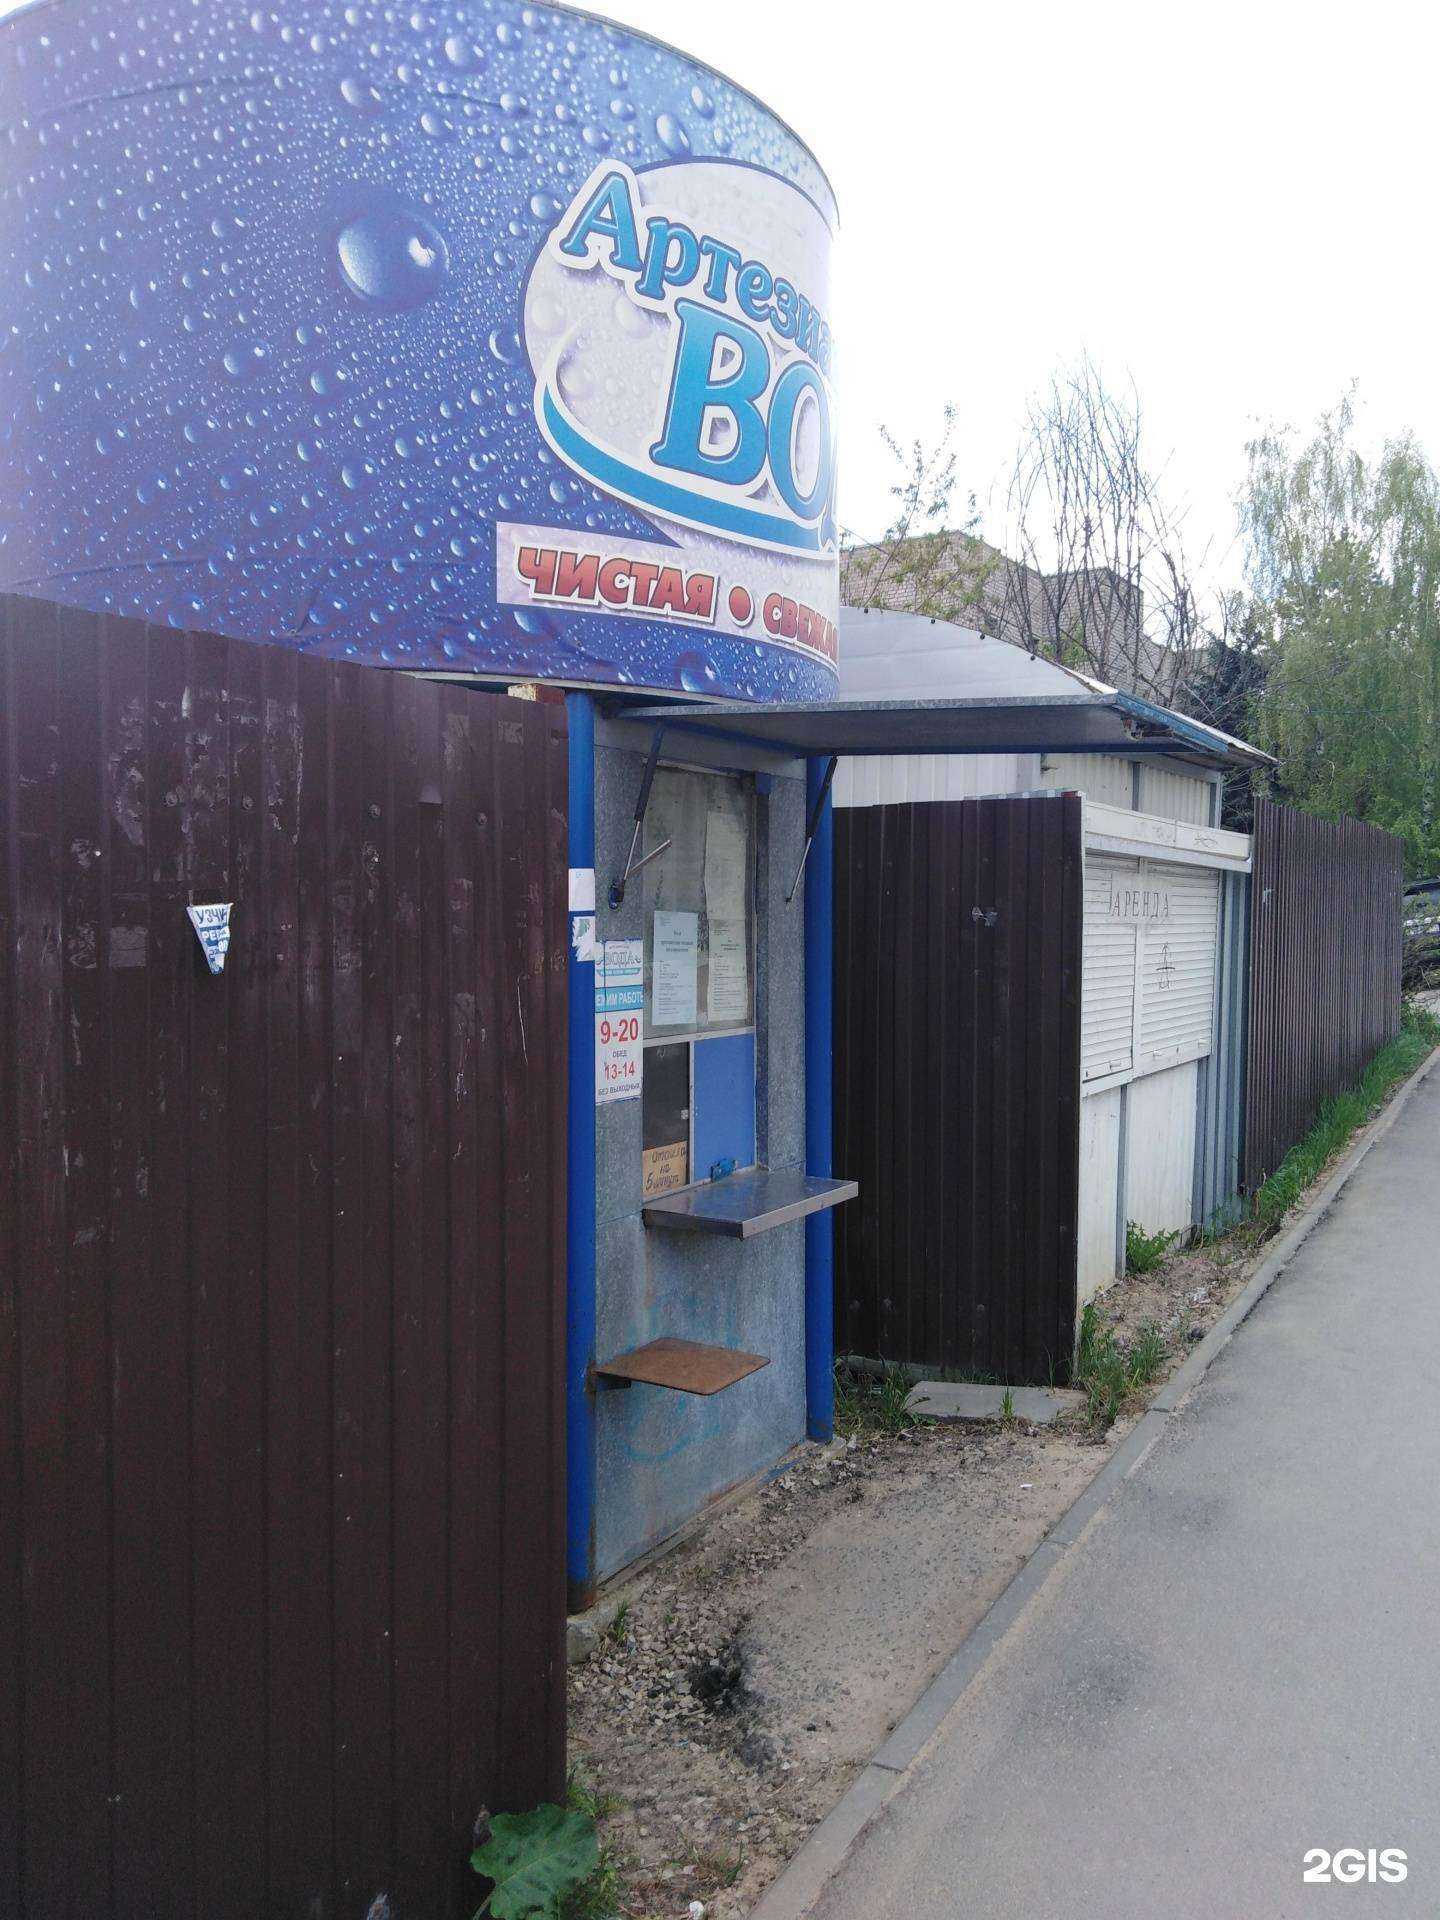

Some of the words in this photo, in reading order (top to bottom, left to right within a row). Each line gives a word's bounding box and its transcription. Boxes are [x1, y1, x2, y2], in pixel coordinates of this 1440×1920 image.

[518, 547, 716, 617] ЧИСТАЯ
[1111, 889, 1169, 919] АРЕНДА
[595, 992, 618, 1008] ЕЖИМ
[601, 1018, 639, 1044] 9-20
[604, 1061, 635, 1080] 13-14
